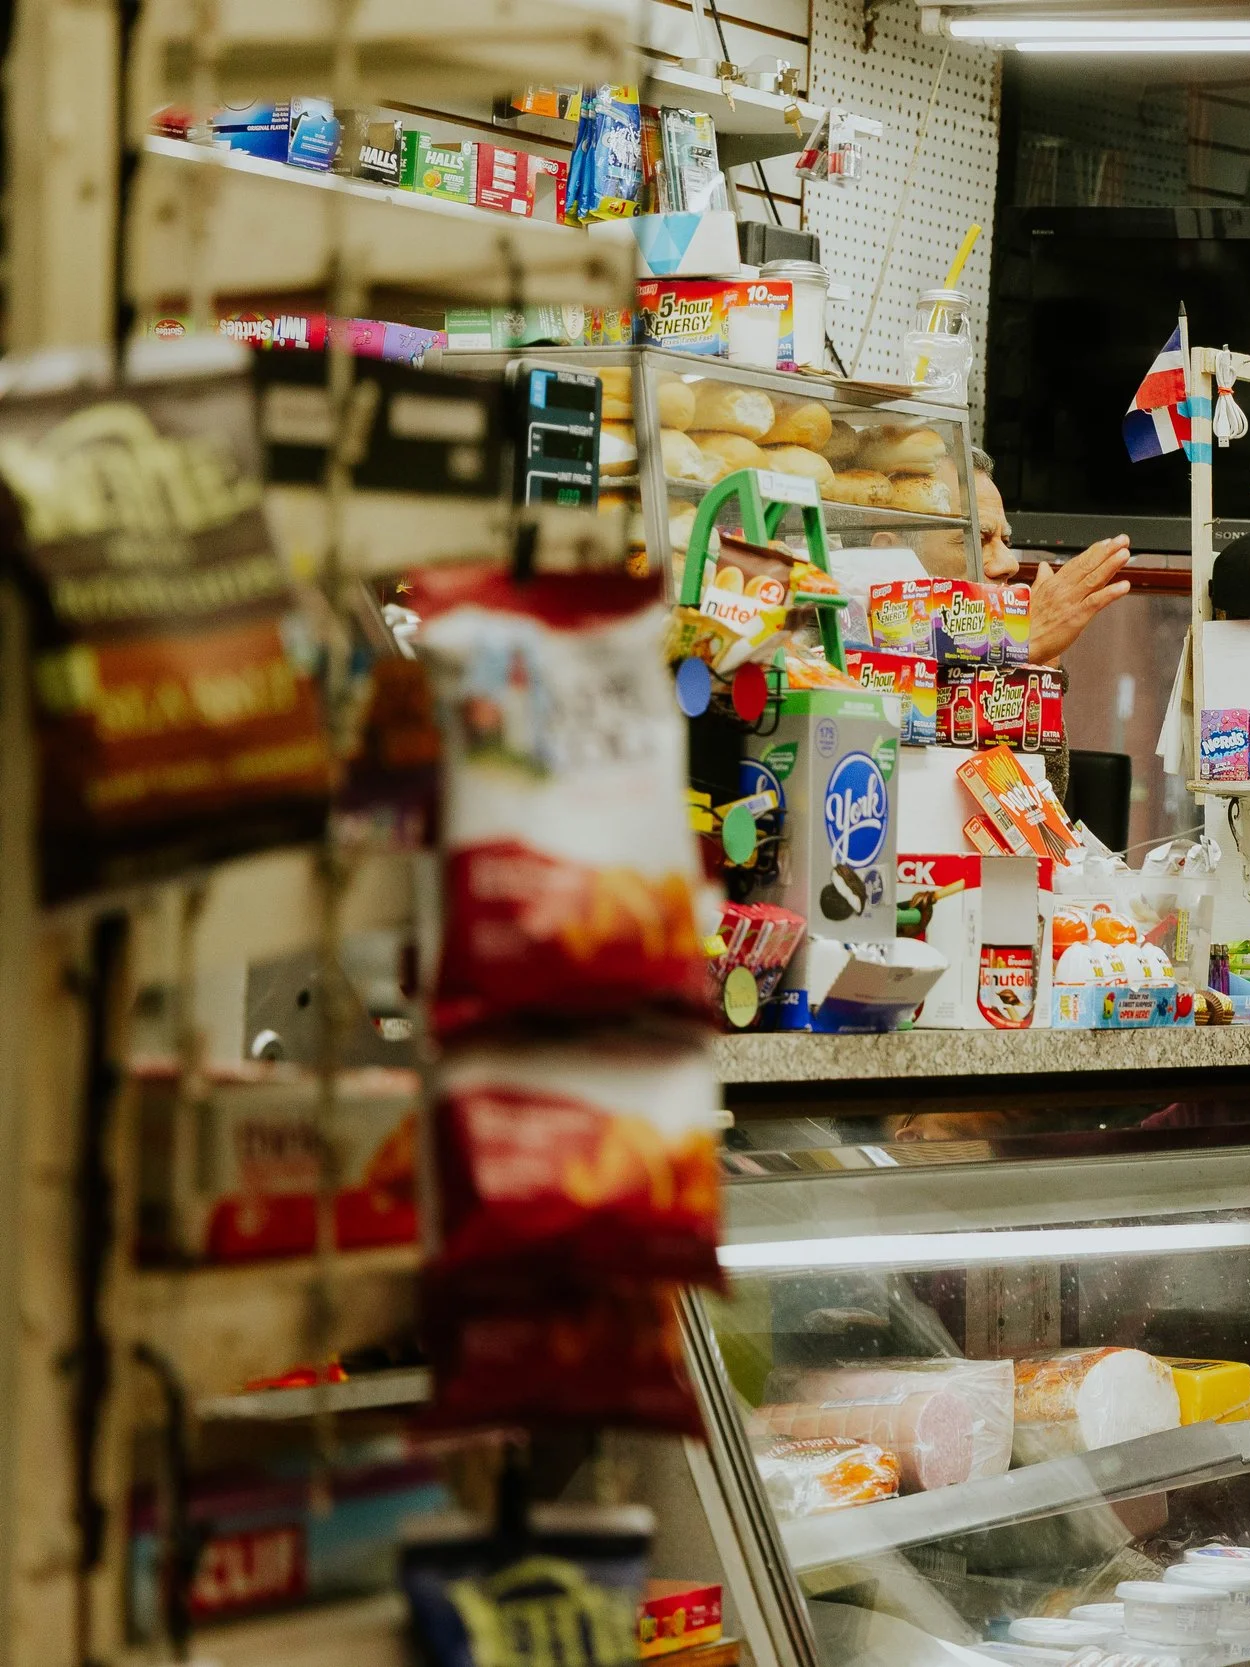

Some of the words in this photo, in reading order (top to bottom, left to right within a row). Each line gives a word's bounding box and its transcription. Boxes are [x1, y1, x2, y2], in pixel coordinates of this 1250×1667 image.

[270, 124, 289, 132] FLAVOR
[747, 286, 769, 302] 10
[659, 293, 713, 318] 5-hour
[219, 319, 273, 342] Skittles
[655, 315, 711, 337] ENERGY
[577, 374, 597, 386] PRICE
[573, 474, 592, 485] PRICE
[873, 585, 892, 598] Grape
[902, 582, 916, 594] 10
[933, 581, 952, 593] Grape
[953, 592, 985, 616] 5-hour
[1002, 591, 1015, 605] 10
[883, 600, 908, 615] 5-hour
[881, 610, 909, 623] ENERGY
[949, 615, 984, 634] ENERGY
[861, 664, 895, 688] 5-hour
[915, 662, 926, 678] 10
[948, 668, 961, 678] 10
[1042, 674, 1052, 689] 10
[993, 678, 1024, 702] 5-hour
[991, 699, 1022, 720] ENERGY
[825, 773, 882, 866] York
[1120, 1010, 1134, 1019] OPEN
